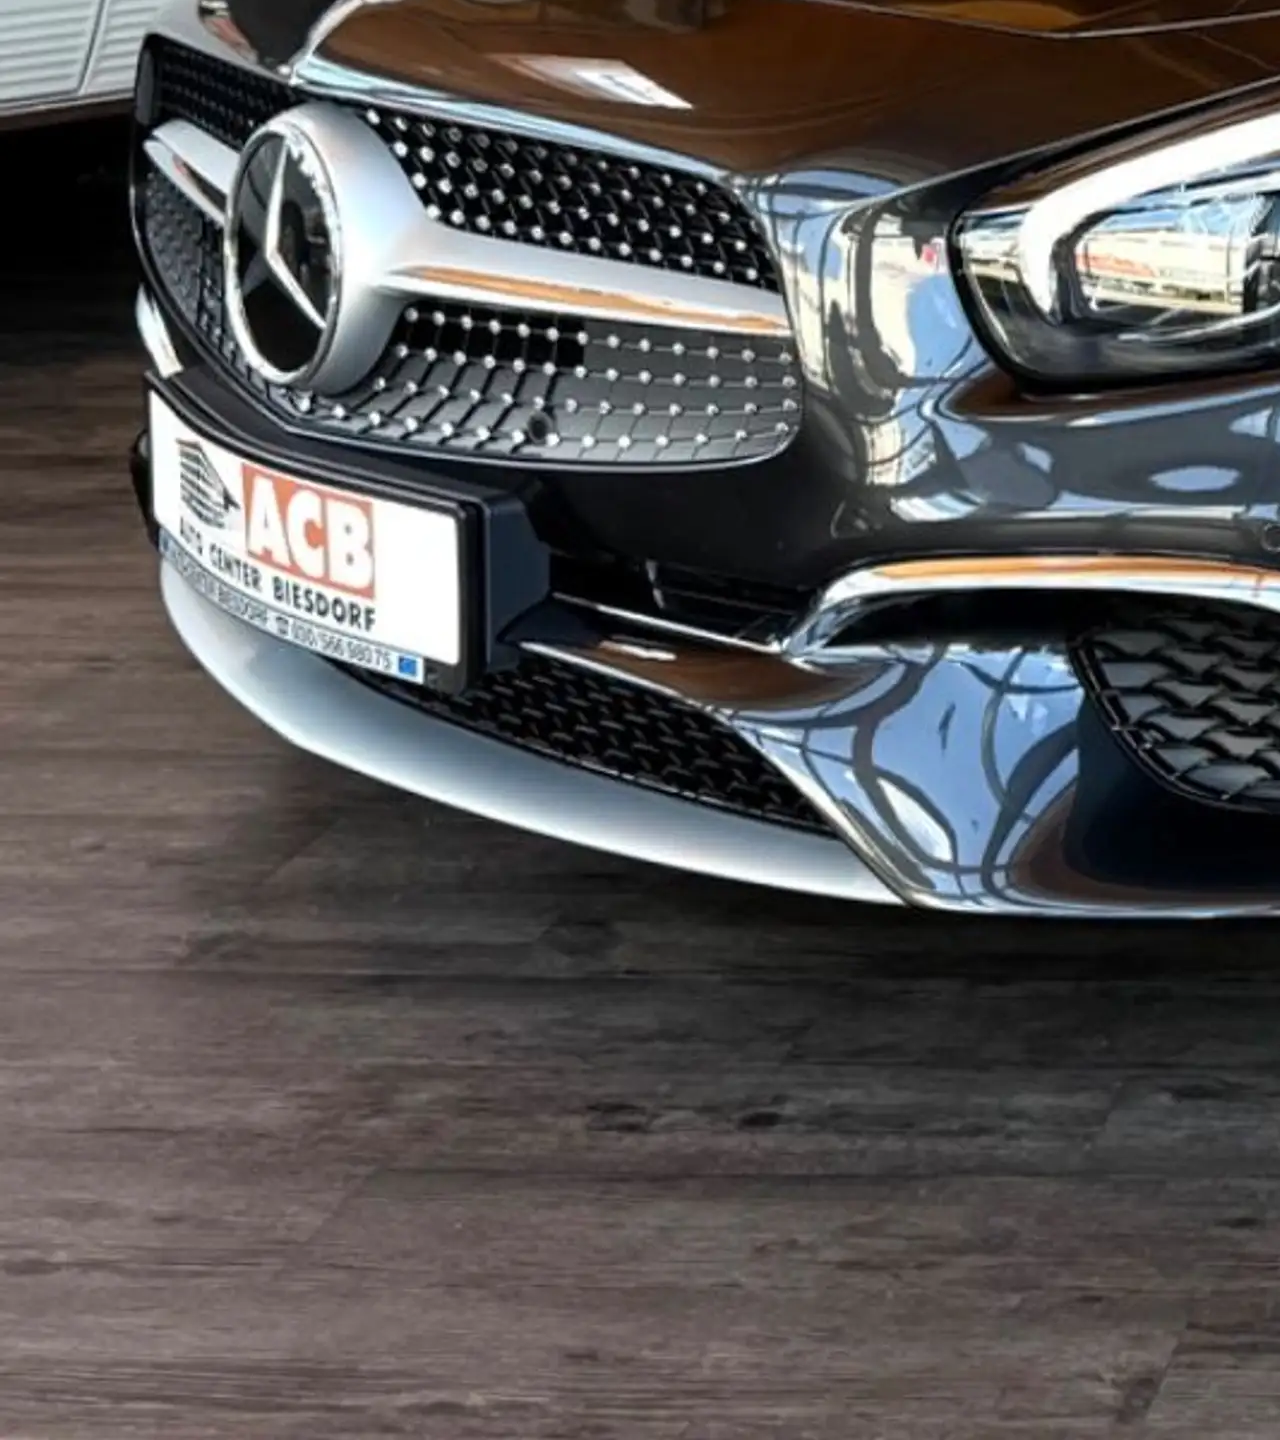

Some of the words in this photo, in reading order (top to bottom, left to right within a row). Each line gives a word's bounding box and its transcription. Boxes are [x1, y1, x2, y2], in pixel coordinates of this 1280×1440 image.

[249, 474, 374, 590] ACB
[209, 543, 263, 593] CENTER
[273, 575, 376, 633] BIESDORF
